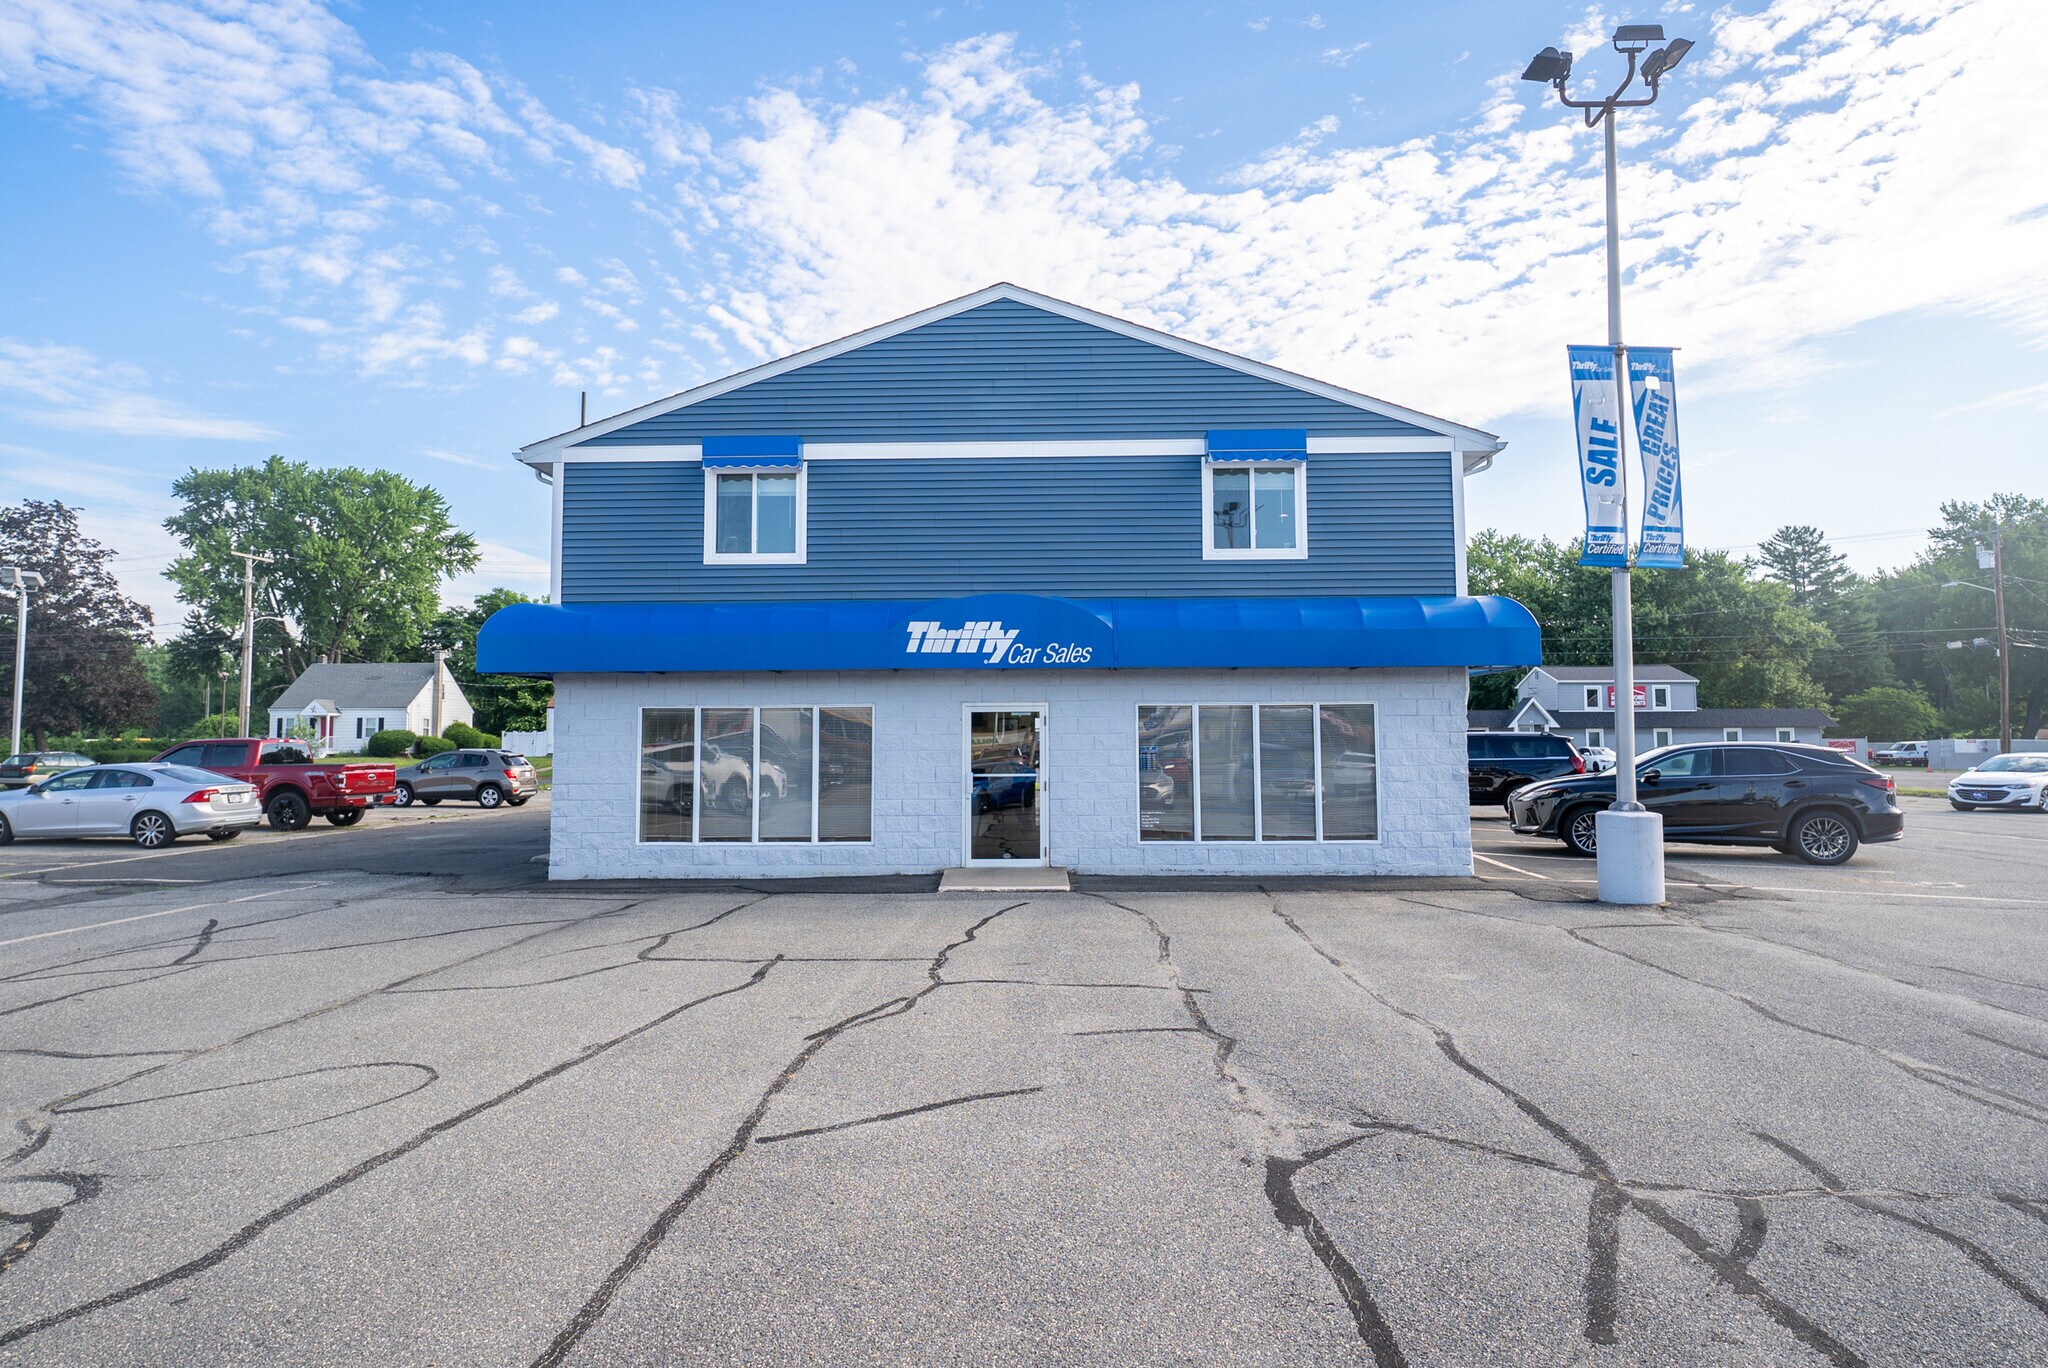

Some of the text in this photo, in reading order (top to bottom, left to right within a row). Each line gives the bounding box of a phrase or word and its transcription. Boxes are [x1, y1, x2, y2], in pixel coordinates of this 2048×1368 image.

[1572, 361, 1598, 372] Thrifty
[1631, 362, 1655, 374] Thrifty
[1642, 389, 1670, 457] GREAT
[1585, 416, 1618, 487] SALE
[1647, 442, 1678, 521] PRICES
[1590, 533, 1613, 543] Thrifty
[1646, 533, 1666, 543] Thrifty
[1587, 543, 1625, 555] Certified
[1643, 543, 1680, 554] Certified
[906, 621, 1093, 664] Thrifty Car Sales
